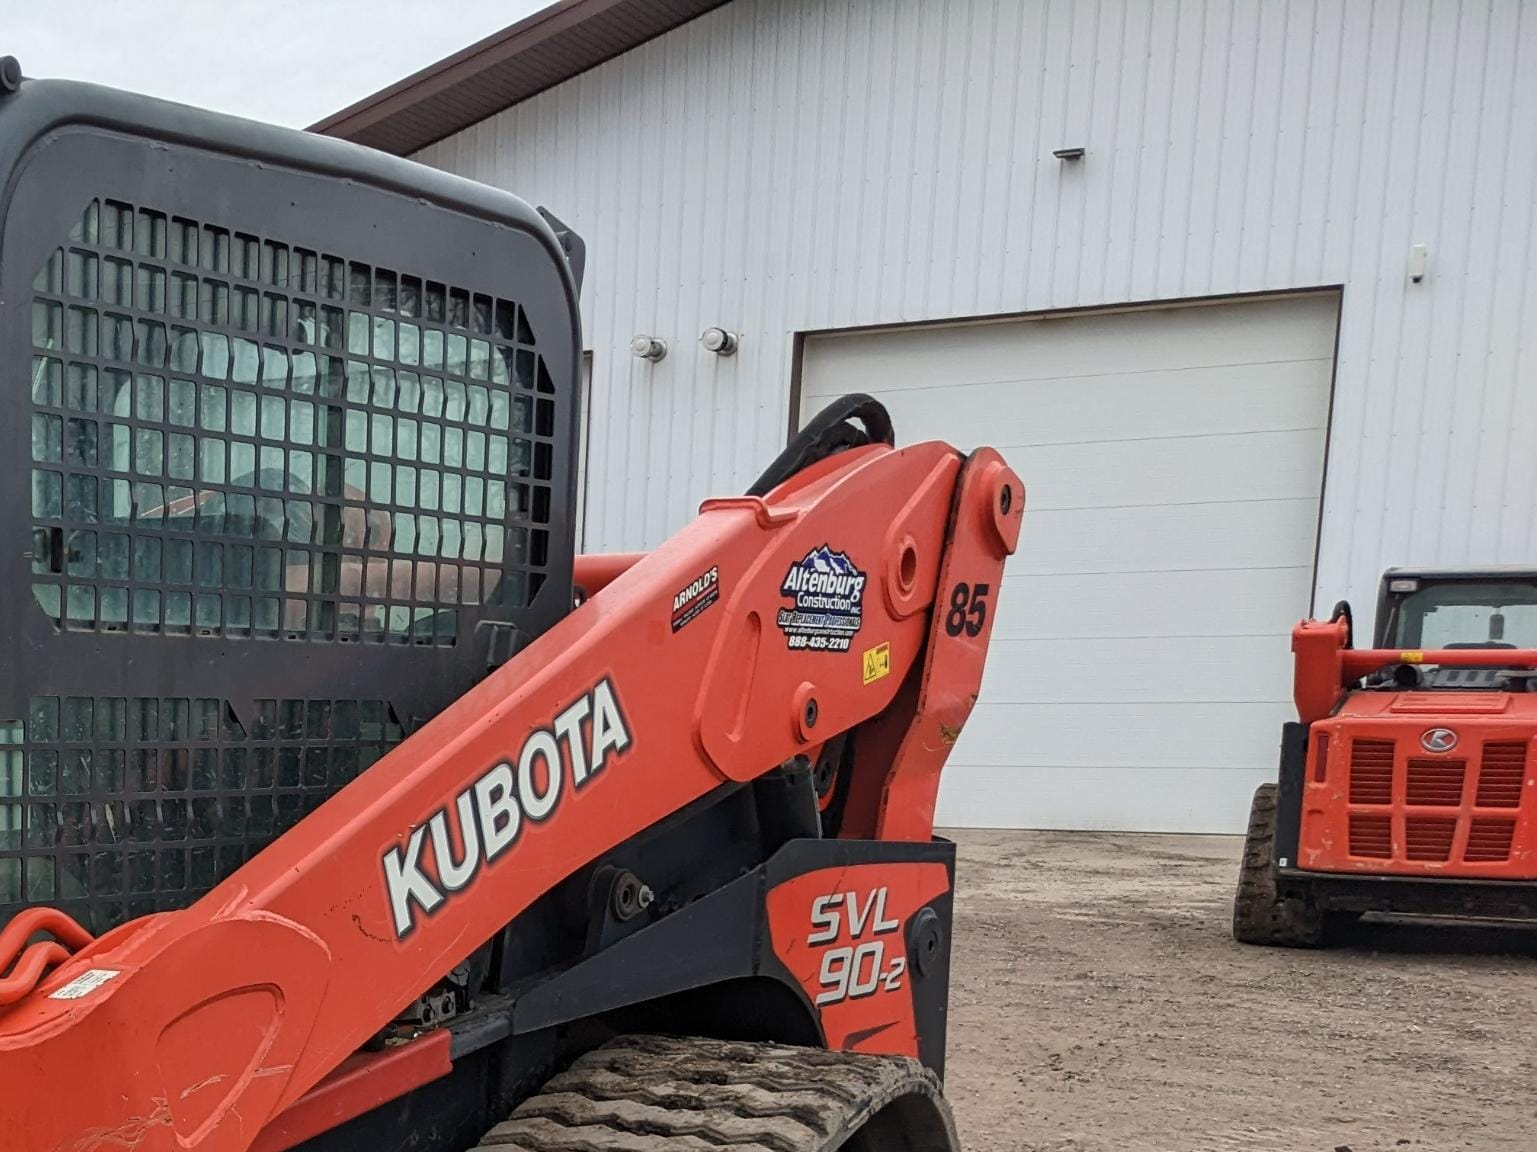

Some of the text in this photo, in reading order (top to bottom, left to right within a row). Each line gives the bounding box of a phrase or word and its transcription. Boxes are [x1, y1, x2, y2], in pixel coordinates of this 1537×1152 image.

[673, 566, 718, 612] ARNOLD'S
[784, 566, 864, 602] Altenburg
[797, 592, 851, 611] Construction
[945, 582, 990, 638] 85
[788, 635, 849, 649] 888-435-2210
[382, 679, 630, 939] KUBOTA
[806, 886, 901, 947] SVL
[815, 940, 906, 1007] 90-2
